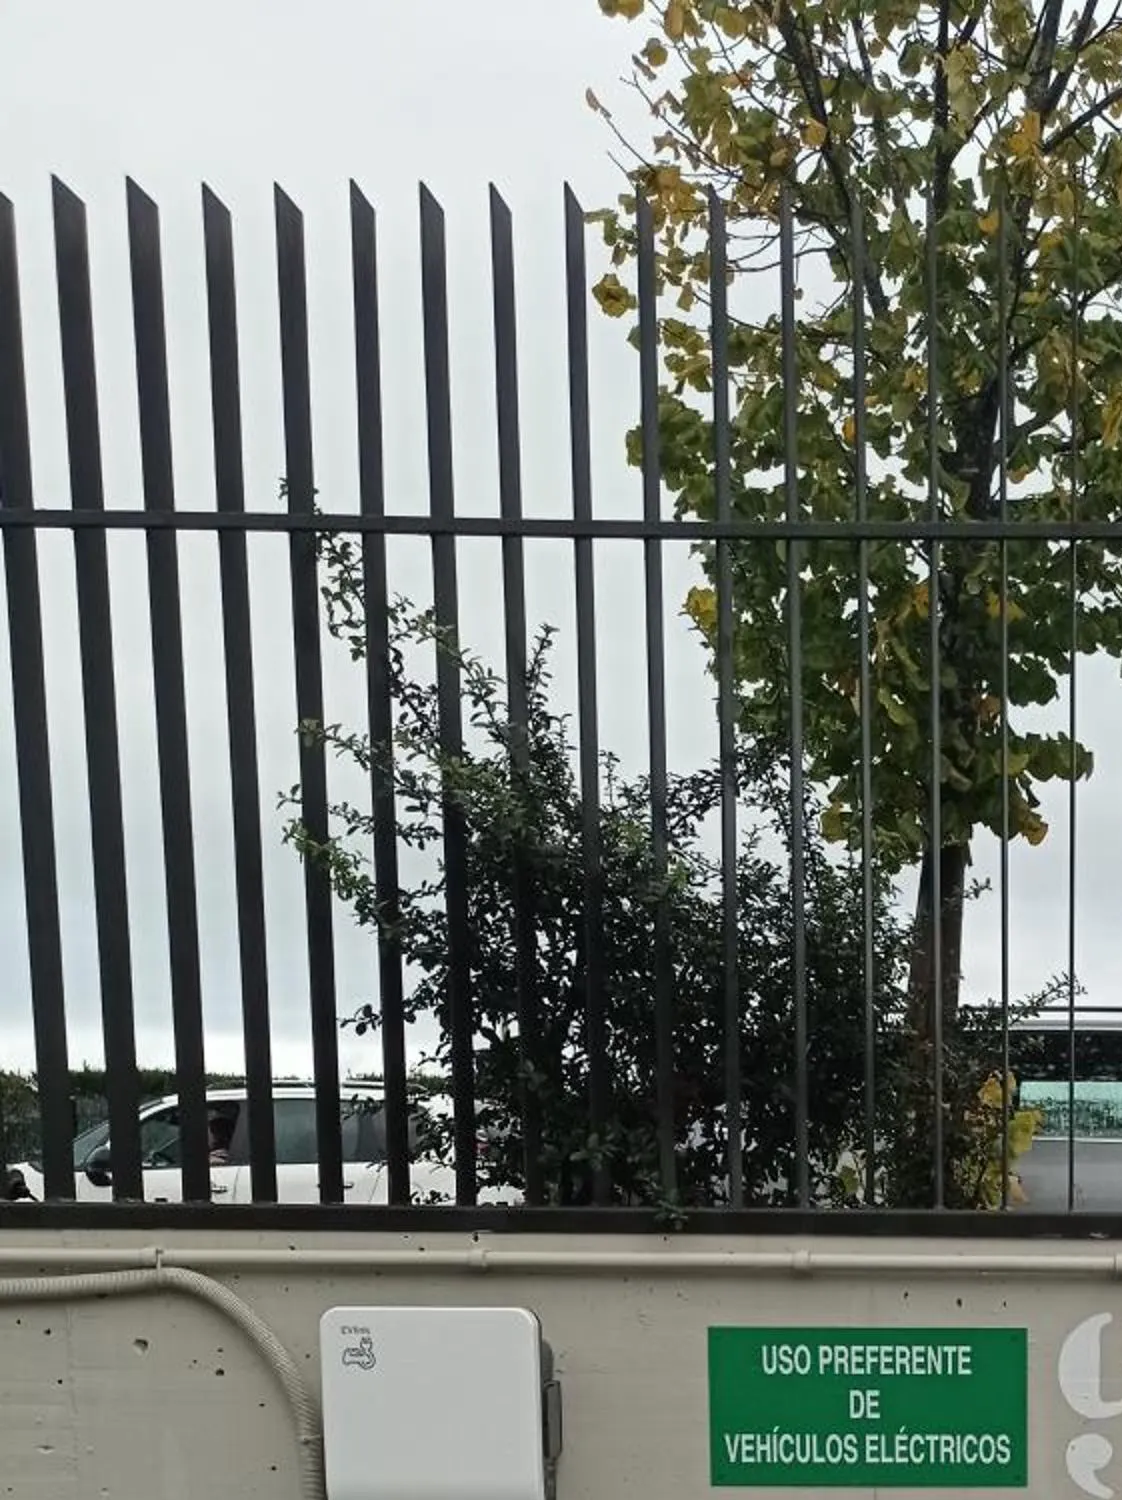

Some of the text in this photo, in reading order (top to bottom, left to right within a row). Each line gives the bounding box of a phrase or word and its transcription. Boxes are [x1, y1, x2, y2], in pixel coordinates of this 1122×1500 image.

[761, 1345, 972, 1375] USO PREFERENTE
[848, 1389, 881, 1419] DE
[724, 1426, 1011, 1464] VEHÍCULOS ELÉCTRICOS
